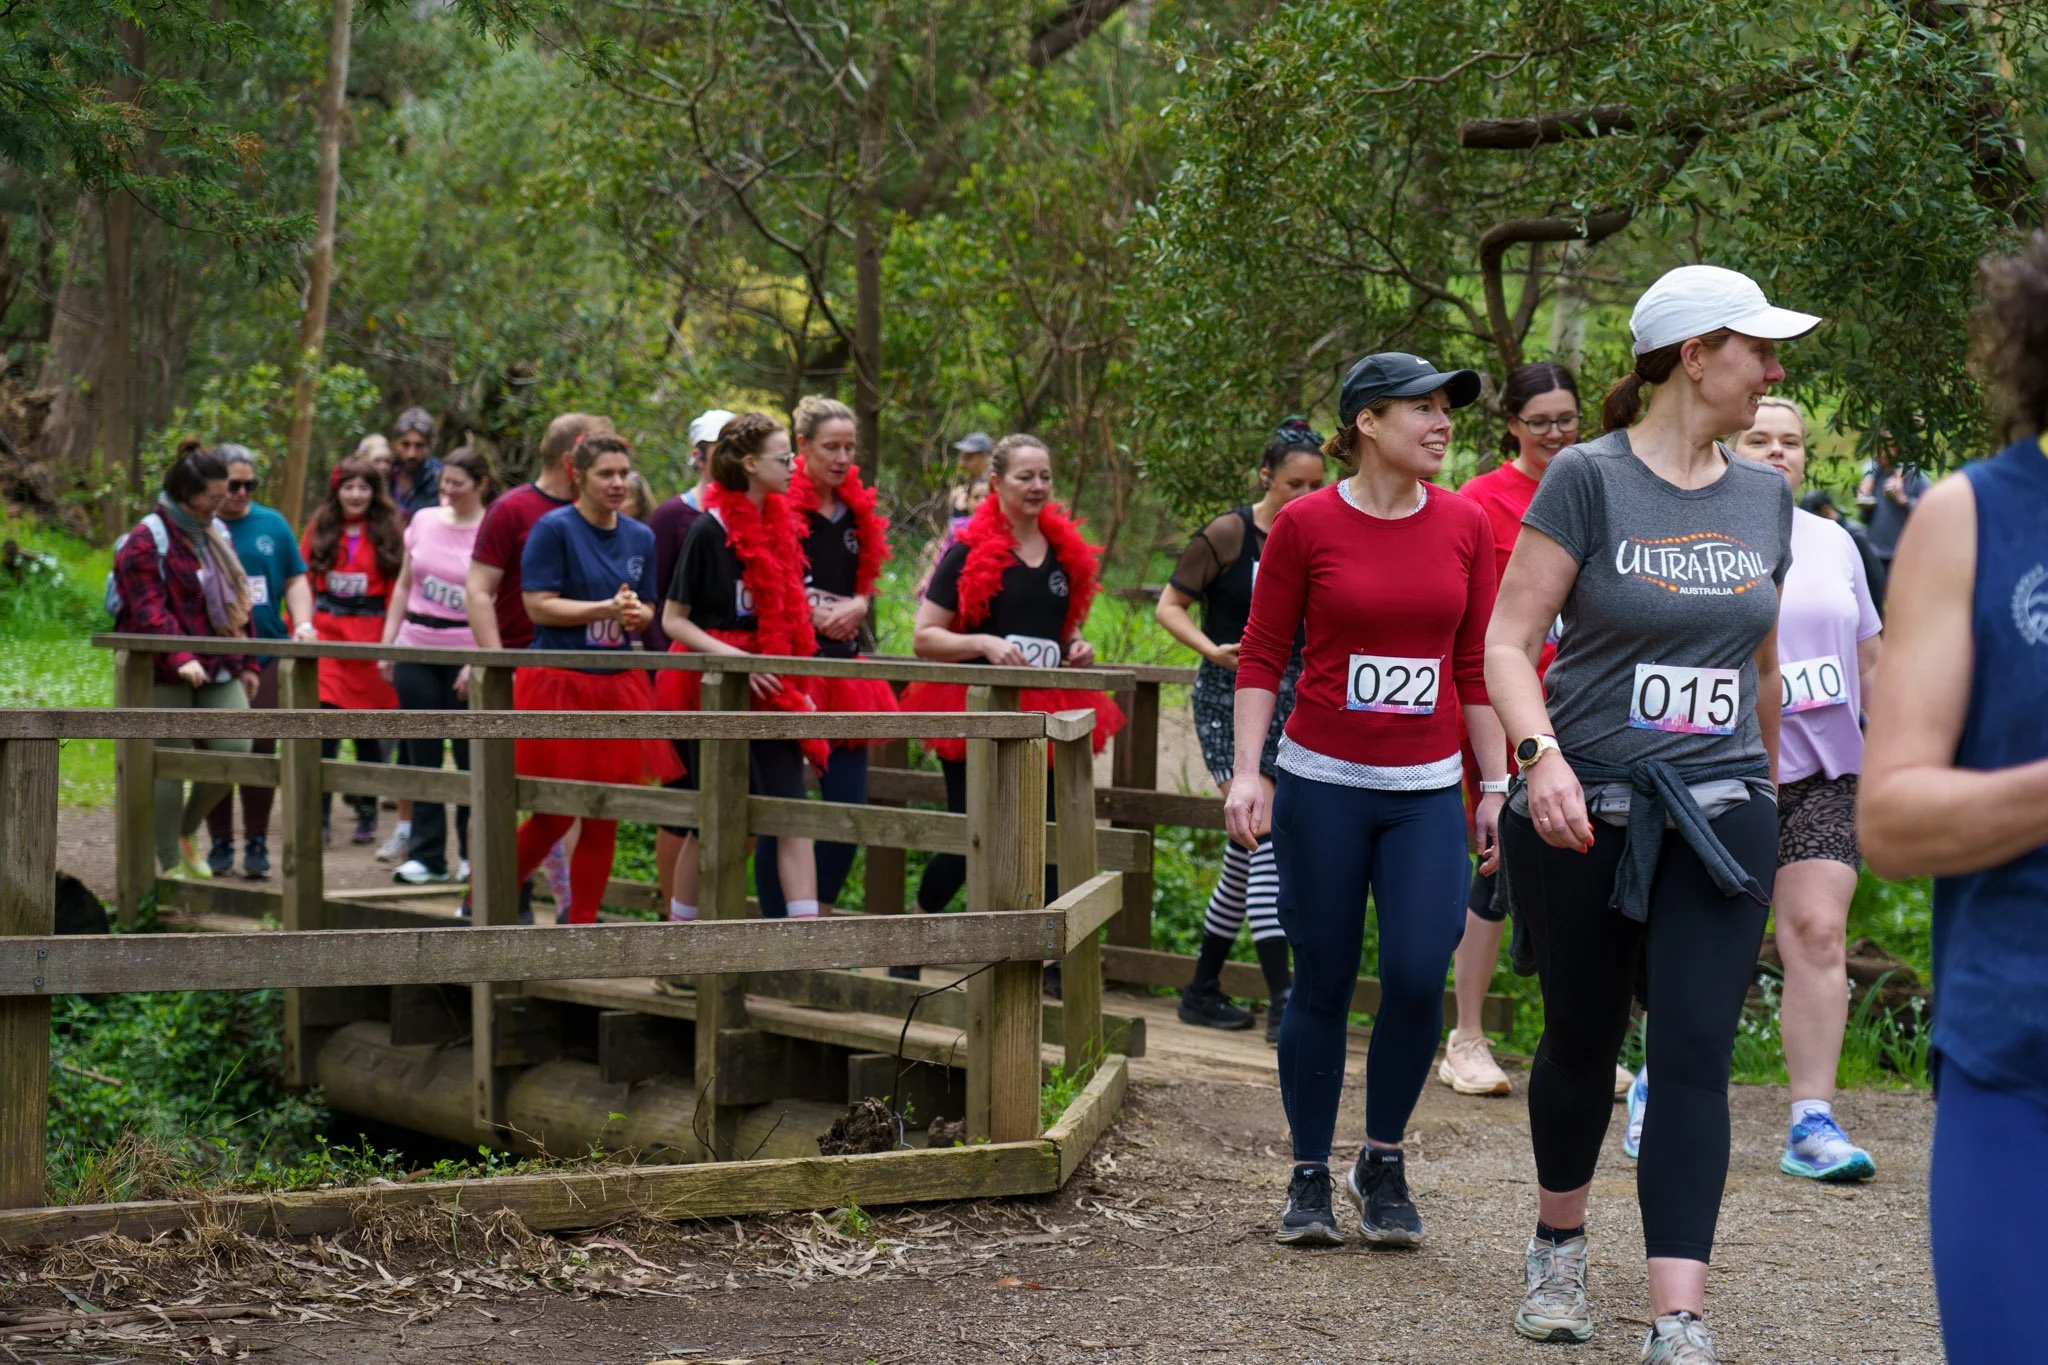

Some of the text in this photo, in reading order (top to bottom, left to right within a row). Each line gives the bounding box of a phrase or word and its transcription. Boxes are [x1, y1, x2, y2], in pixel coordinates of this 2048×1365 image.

[1615, 540, 1768, 583] ULTRA-TRAIL
[424, 581, 464, 610] 016
[1679, 587, 1733, 595] AUSTRALIA
[1353, 663, 1435, 707] 022
[1639, 674, 1734, 726] 015
